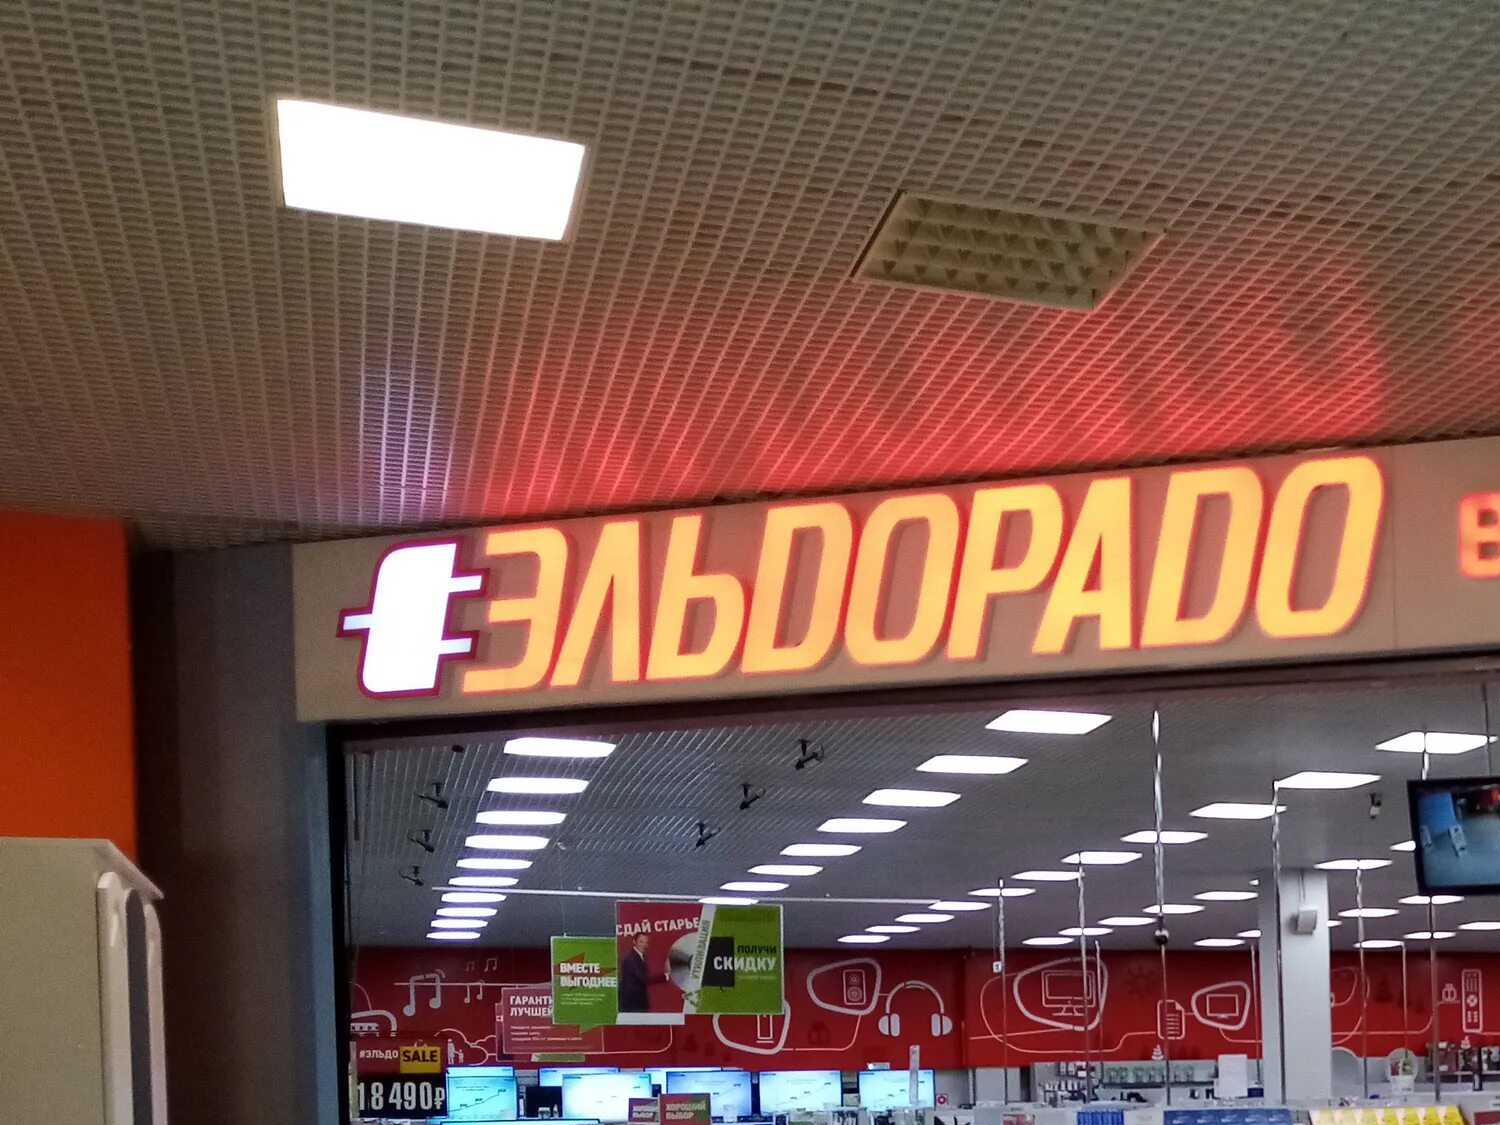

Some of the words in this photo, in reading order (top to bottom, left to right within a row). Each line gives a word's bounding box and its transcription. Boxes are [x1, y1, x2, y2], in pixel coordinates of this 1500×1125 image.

[616, 919, 651, 936] СДАЙ
[559, 962, 601, 975] ВМЕСТЕ
[713, 956, 777, 973] СКИДКУ
[560, 976, 617, 988] ВЫГОДНЕЕ
[403, 1050, 438, 1062] SALE
